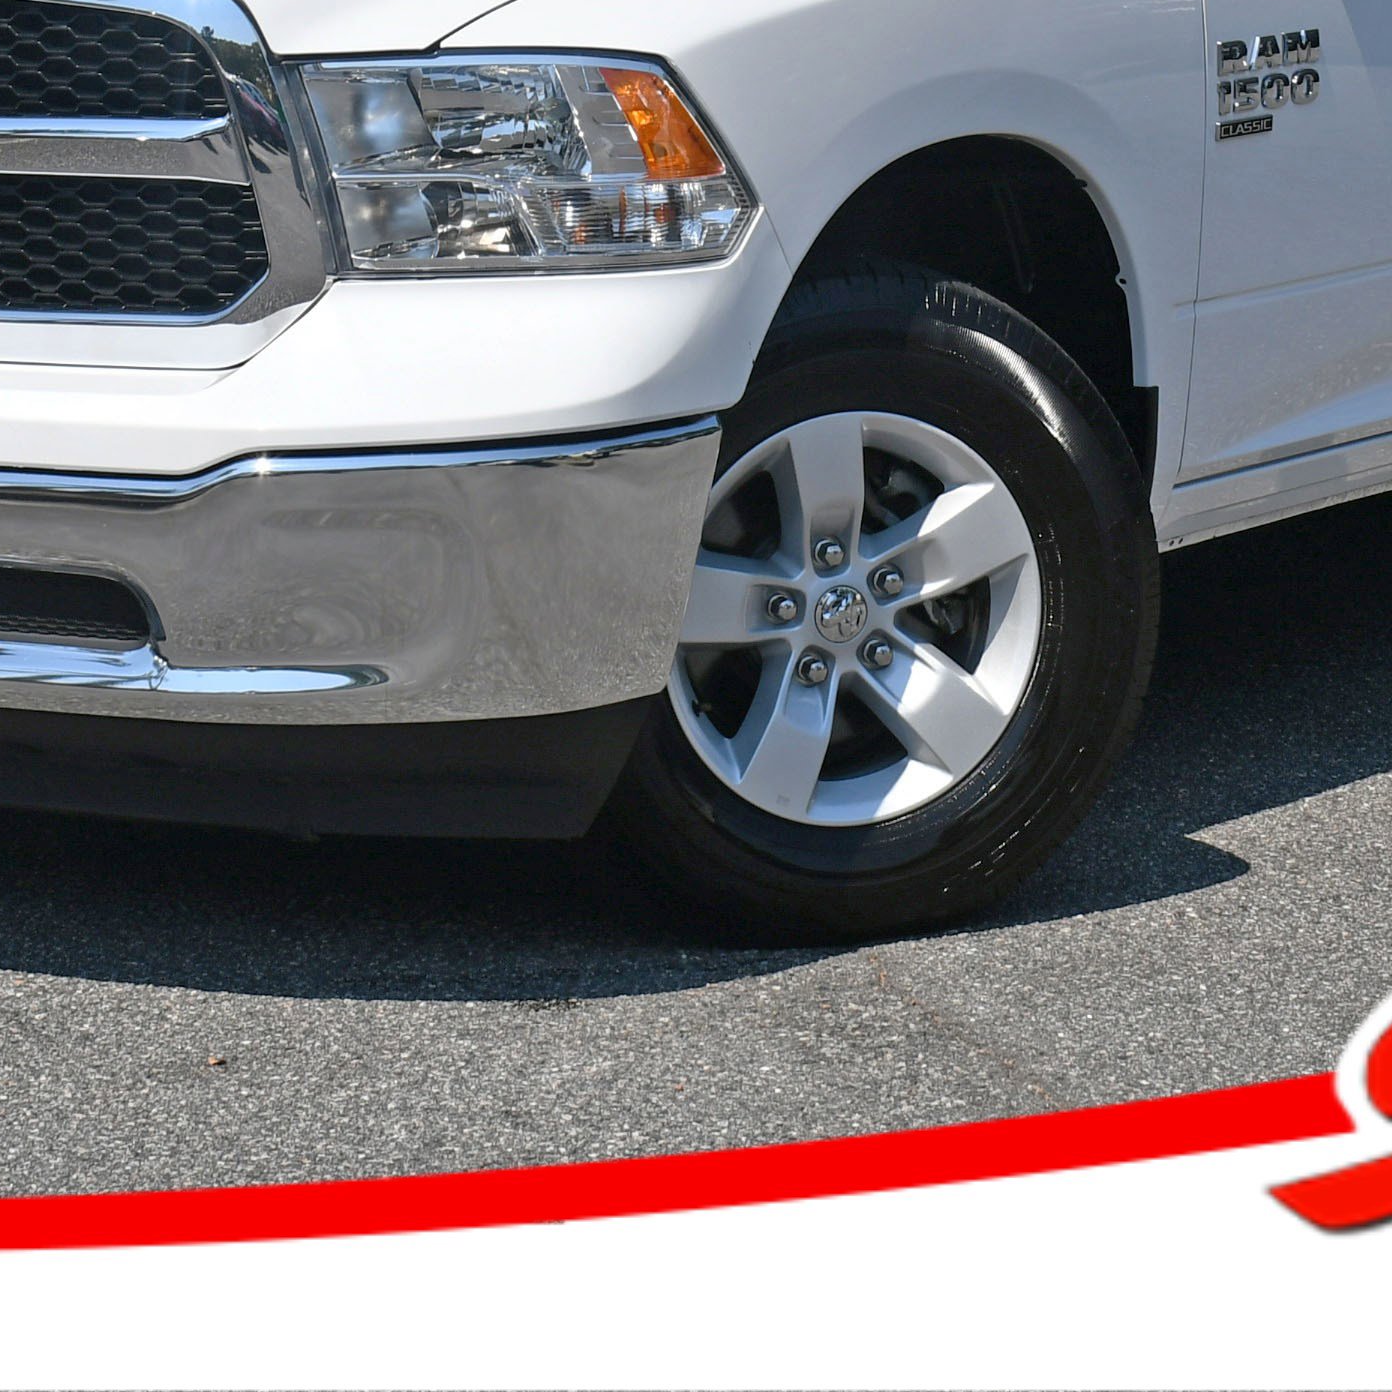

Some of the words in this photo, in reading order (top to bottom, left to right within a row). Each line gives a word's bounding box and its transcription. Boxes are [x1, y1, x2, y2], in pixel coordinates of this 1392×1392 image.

[1216, 28, 1320, 77] RAM
[1217, 68, 1320, 116] 1500
[1220, 118, 1273, 138] CLASSIC
